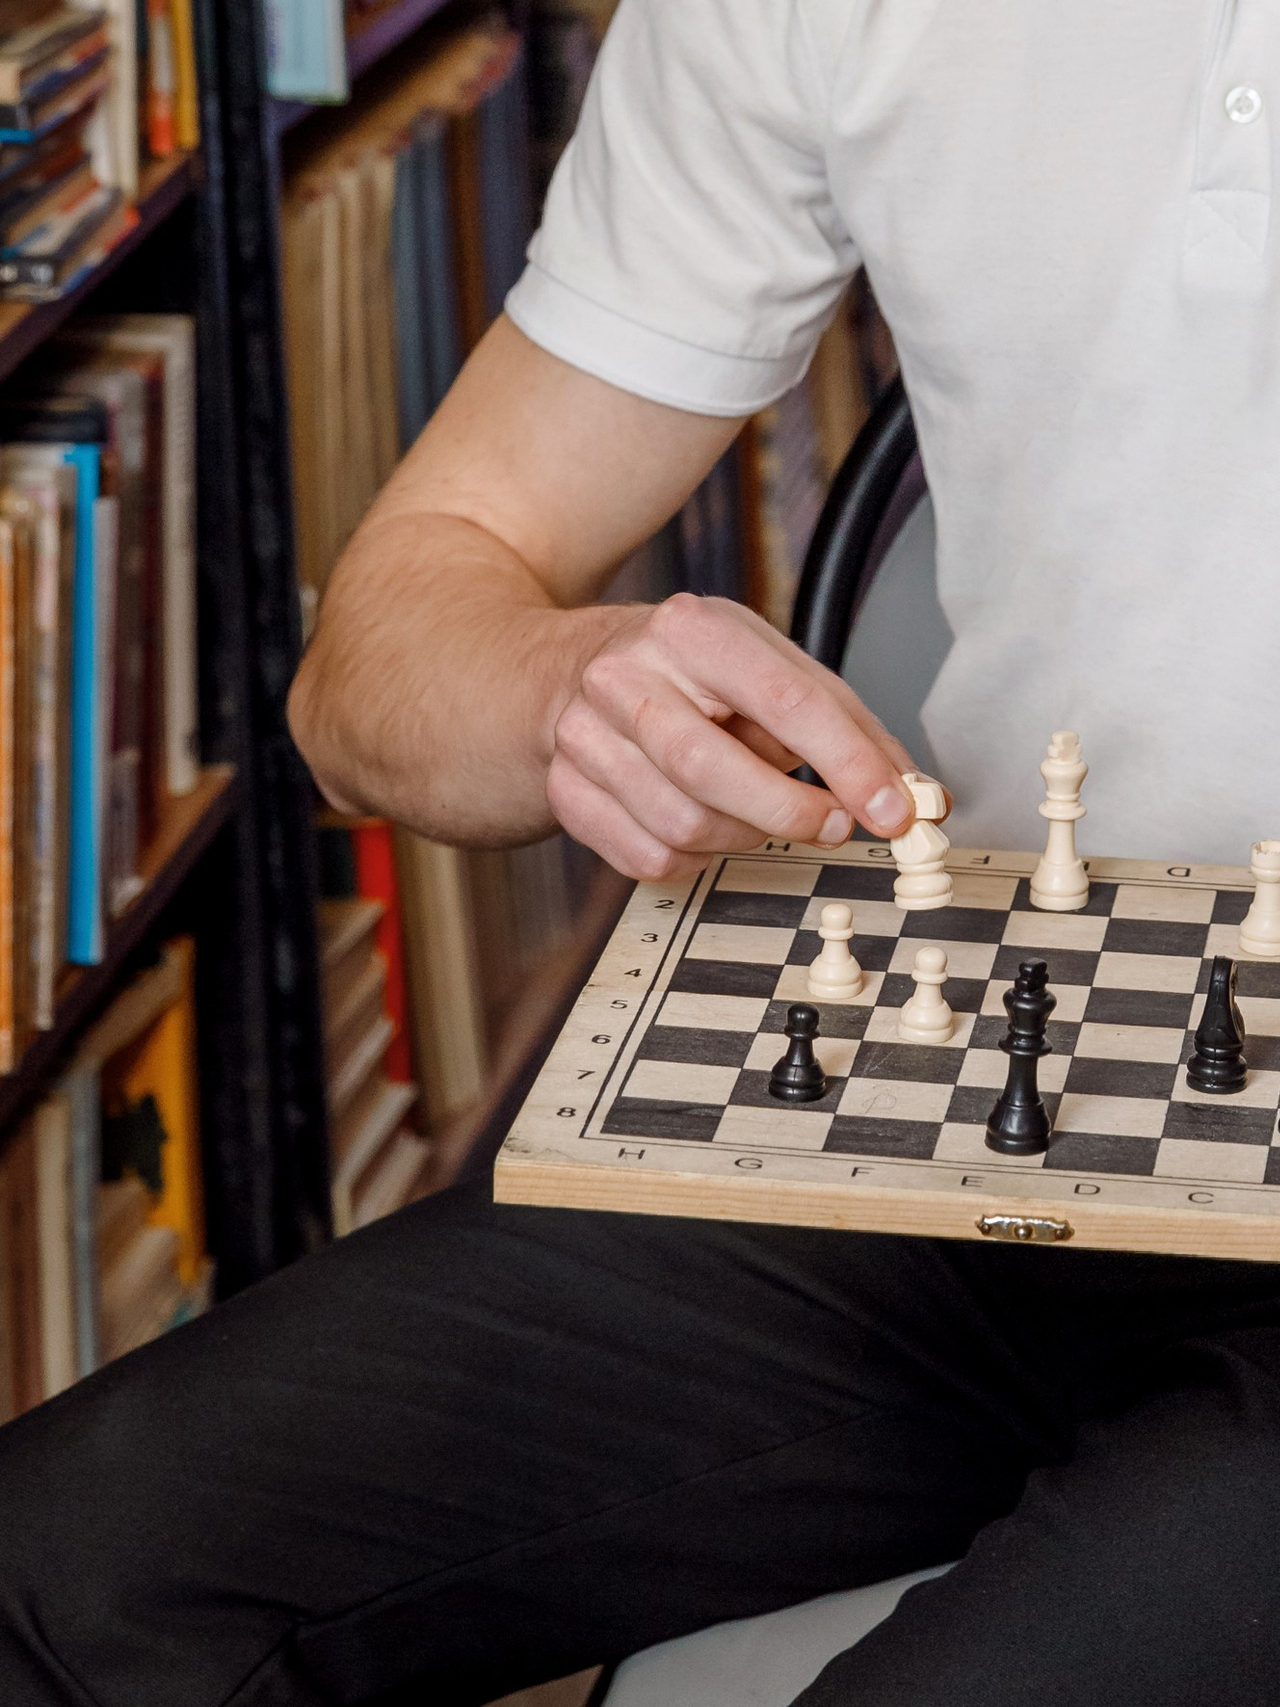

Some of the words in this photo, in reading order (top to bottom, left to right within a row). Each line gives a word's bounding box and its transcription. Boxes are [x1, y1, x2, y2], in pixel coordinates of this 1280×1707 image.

[766, 842, 790, 852] H
[868, 848, 893, 858] G
[970, 855, 990, 864] F
[1167, 867, 1191, 877] D
[655, 899, 676, 910] 2
[641, 932, 659, 942] 3
[624, 966, 642, 977] 4
[610, 999, 628, 1009] 5
[591, 1034, 612, 1045] 6
[577, 1069, 596, 1080] 7
[557, 1107, 577, 1118] 8
[618, 1148, 645, 1160] H
[734, 1157, 763, 1170] G
[851, 1167, 875, 1177] F
[961, 1176, 986, 1187] E
[1074, 1183, 1101, 1195] D
[1188, 1192, 1214, 1204] C
